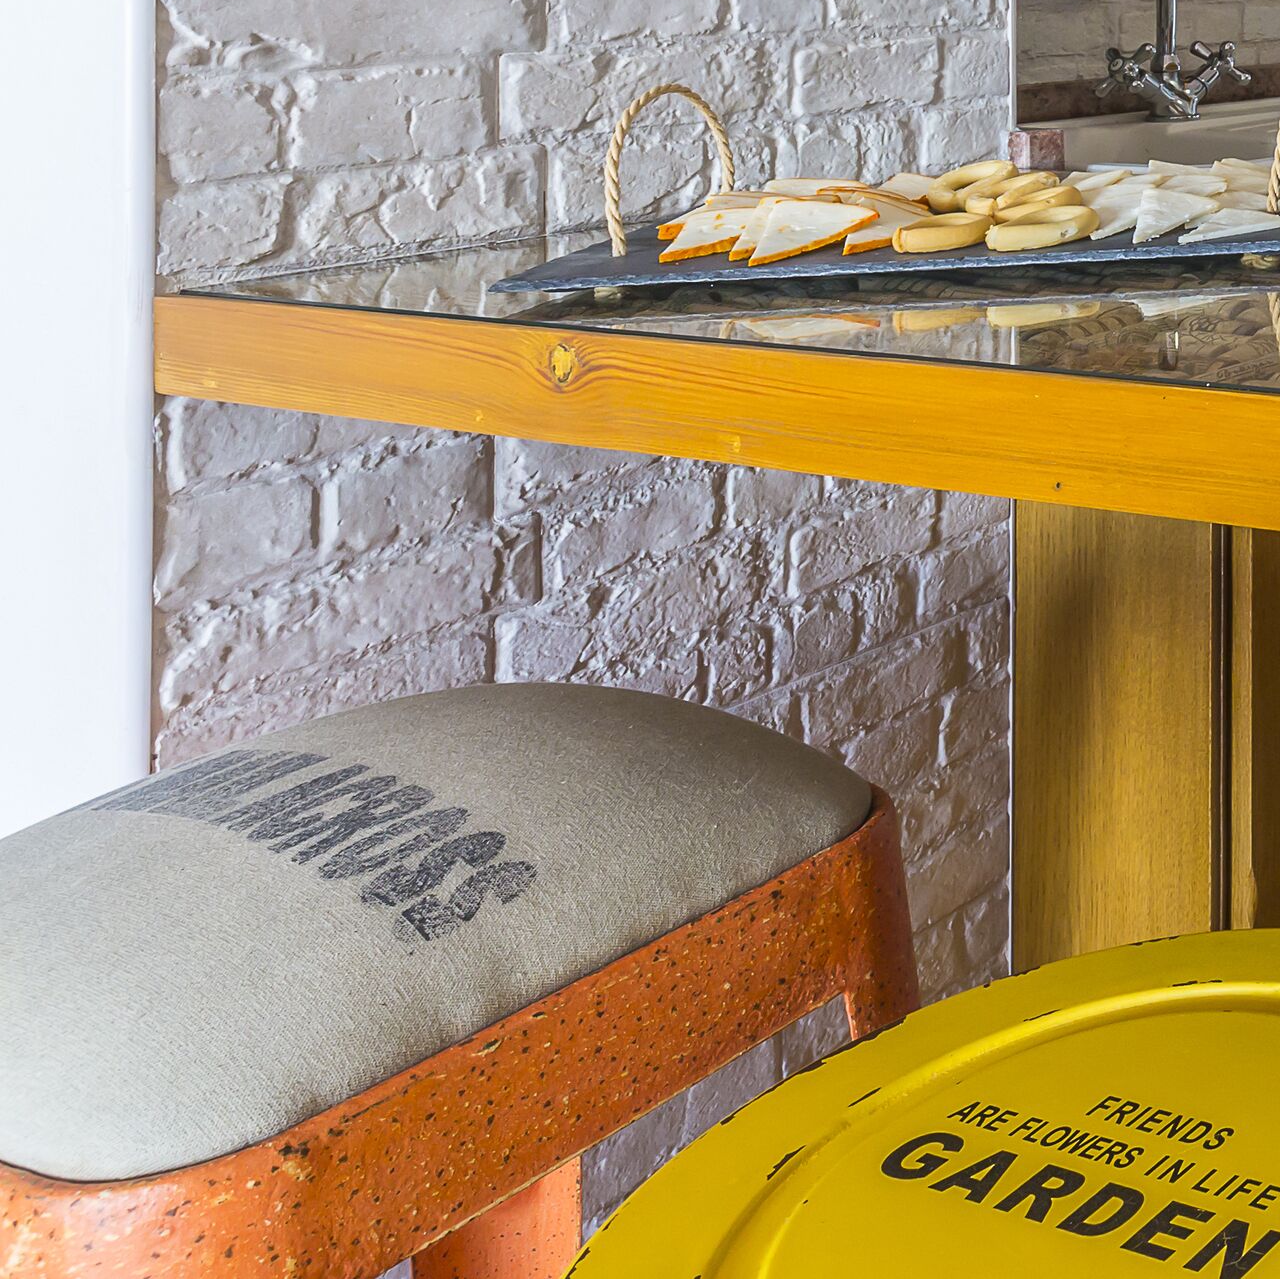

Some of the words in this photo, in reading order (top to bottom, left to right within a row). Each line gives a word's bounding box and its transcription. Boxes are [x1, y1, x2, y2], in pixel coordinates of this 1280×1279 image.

[947, 1101, 1018, 1132] ARE
[1008, 1116, 1145, 1169] FLOWERS
[1144, 1154, 1196, 1184] IN
[1085, 1095, 1234, 1150] FRIENDS
